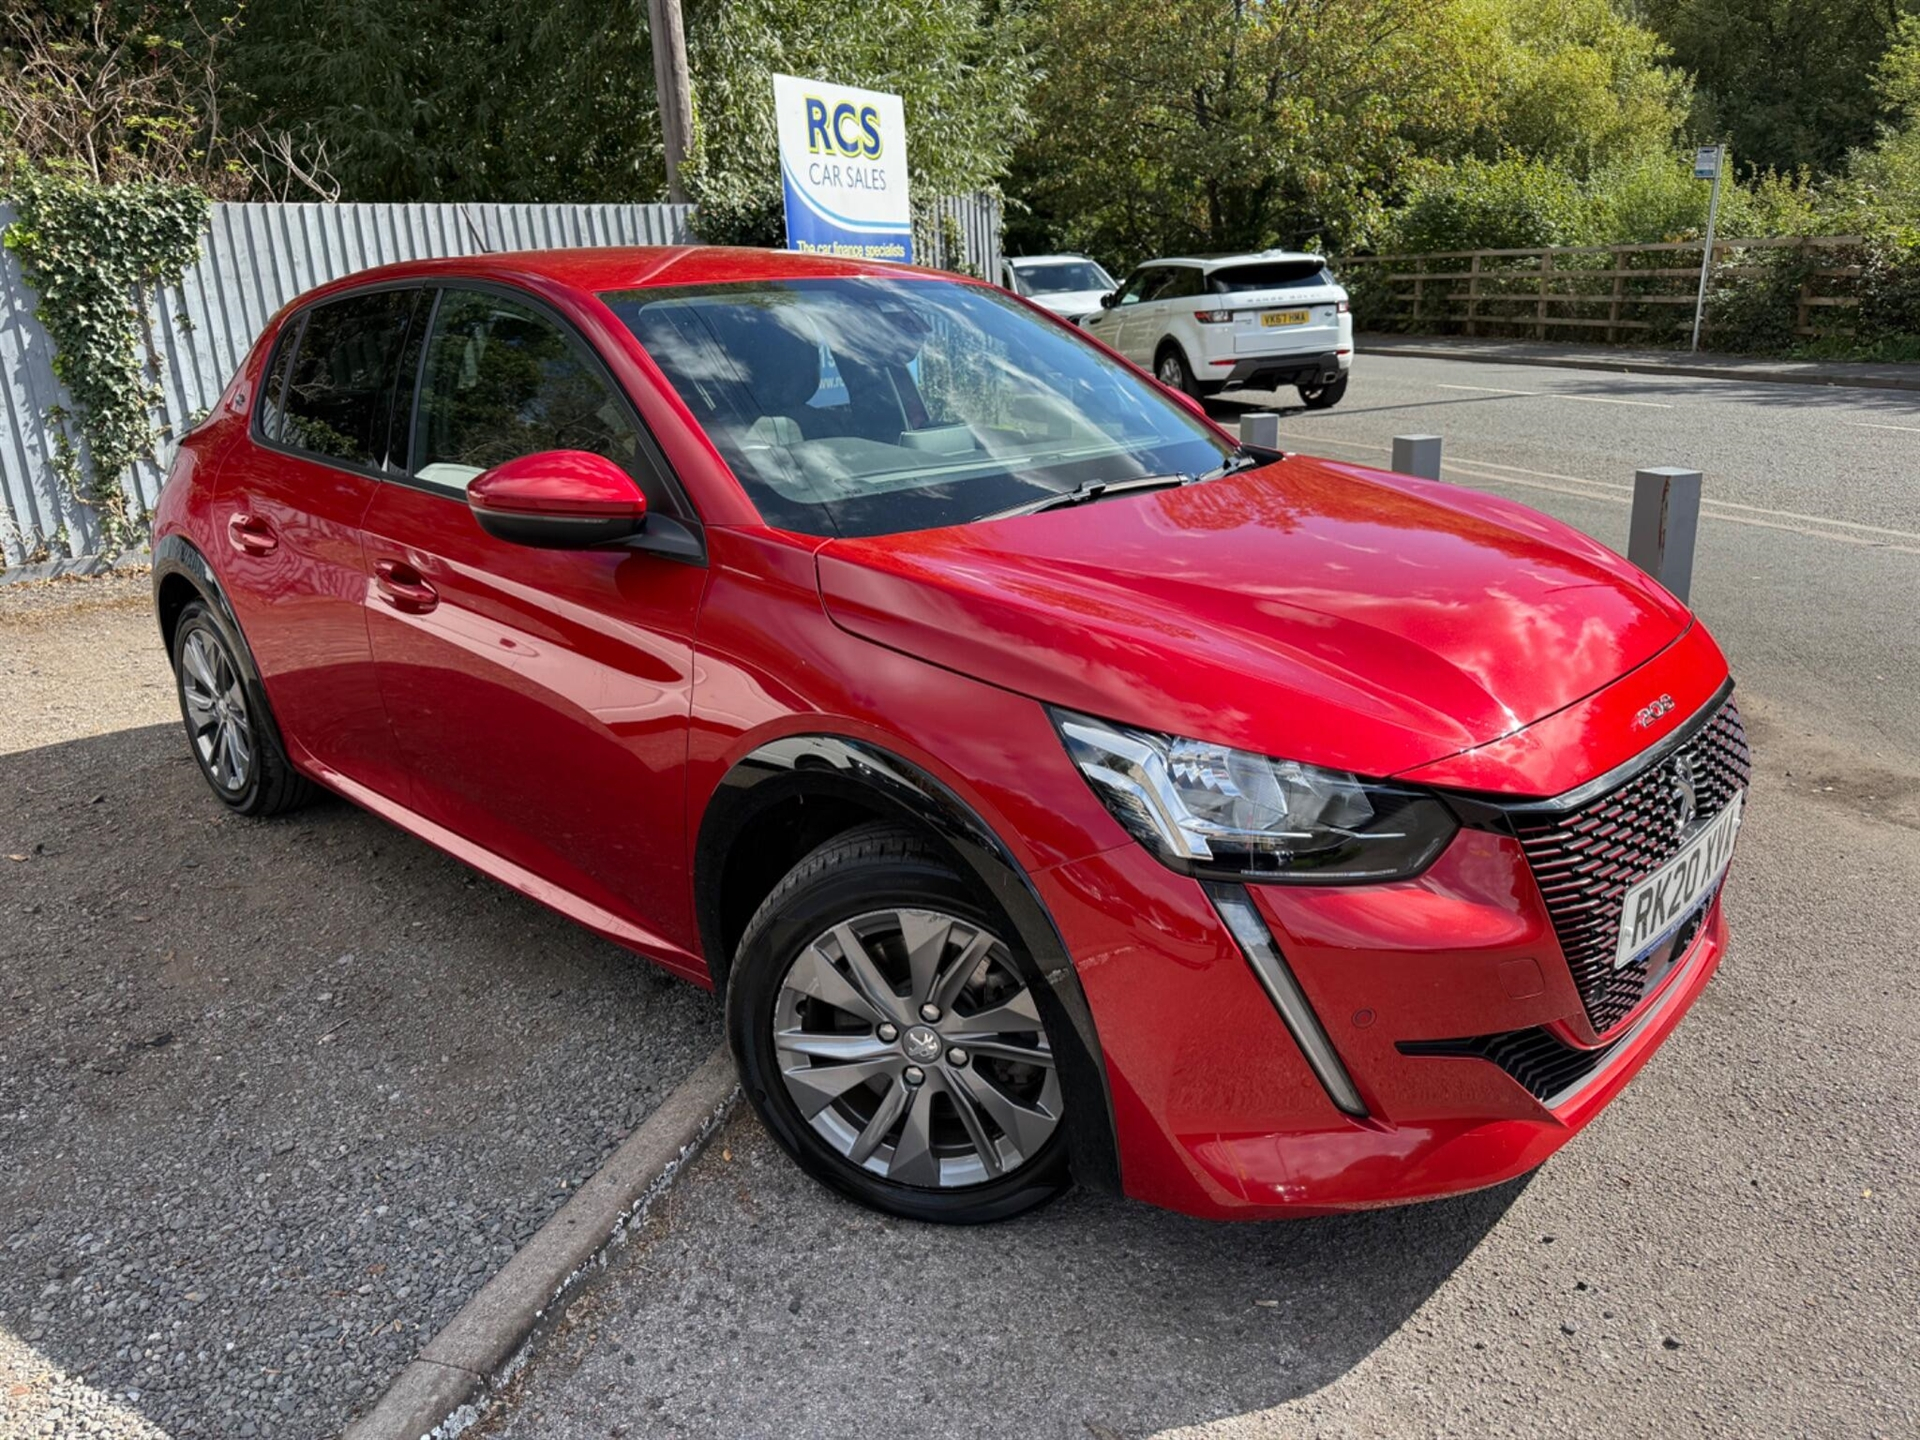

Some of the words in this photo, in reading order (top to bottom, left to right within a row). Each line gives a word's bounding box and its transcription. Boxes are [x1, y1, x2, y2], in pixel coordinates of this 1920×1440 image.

[805, 95, 882, 159] RCS
[809, 163, 842, 188] CAR
[846, 166, 887, 191] SALES
[796, 240, 815, 254] The
[817, 244, 831, 254] car
[865, 242, 905, 258] specialists
[1635, 693, 1675, 728] 208
[1631, 847, 1701, 949] RK20
